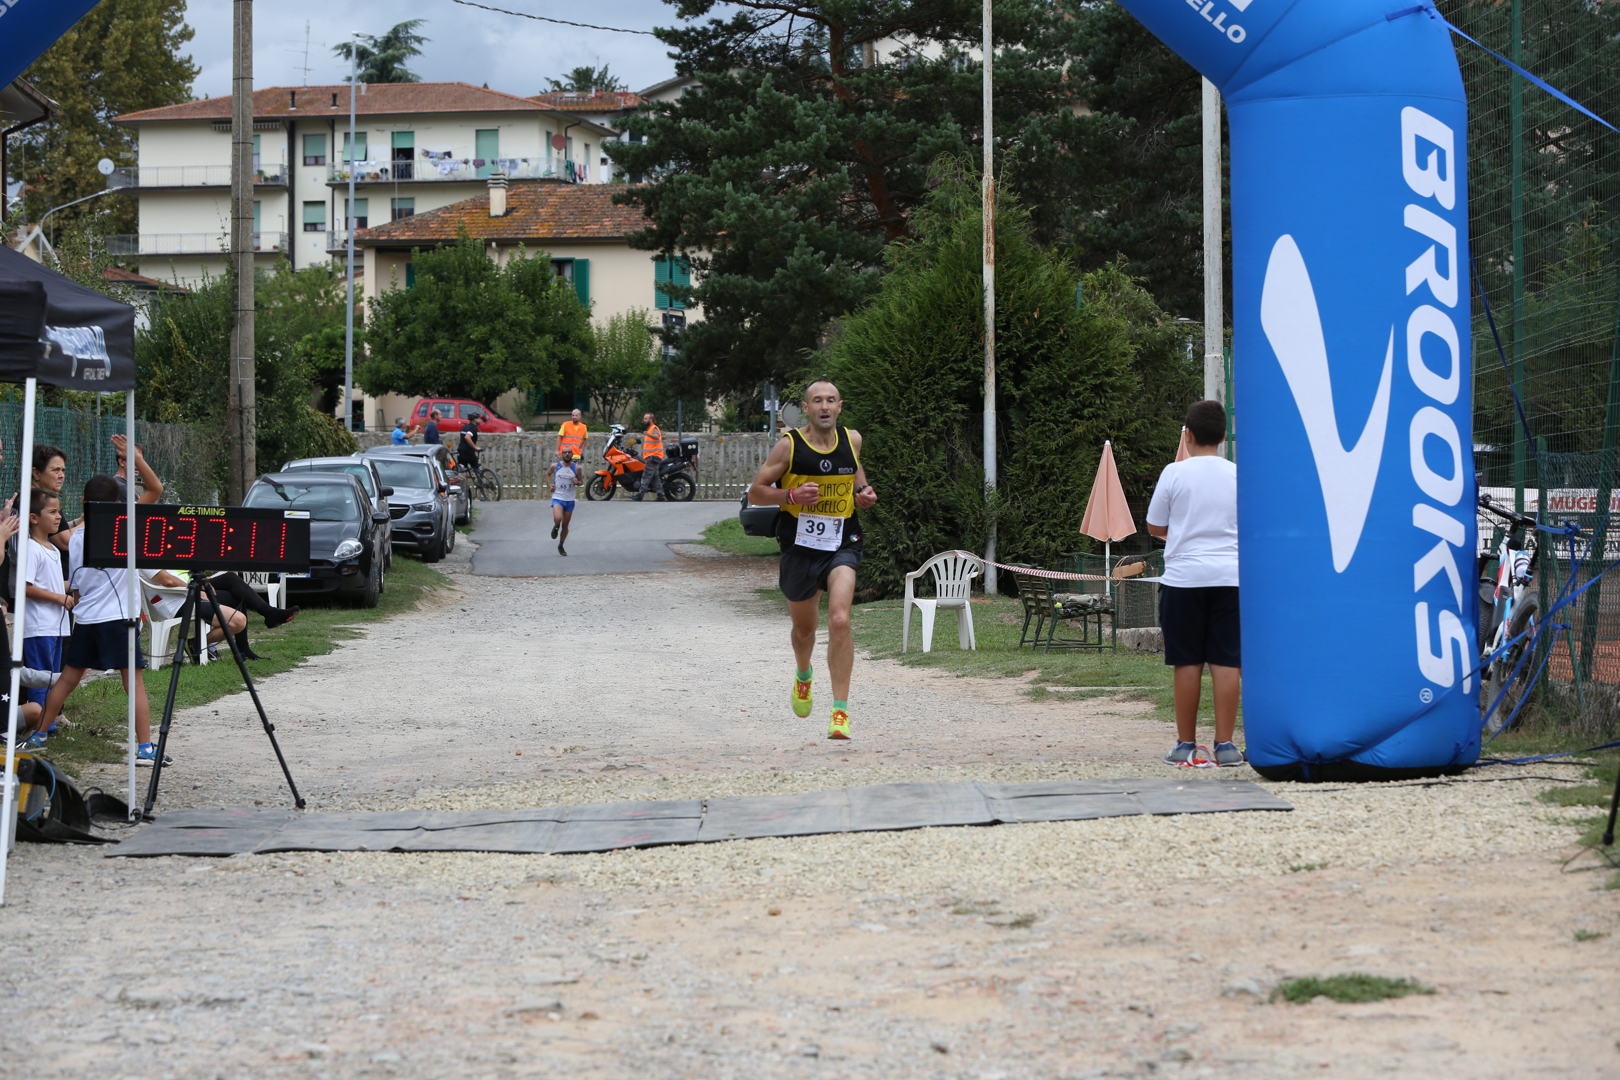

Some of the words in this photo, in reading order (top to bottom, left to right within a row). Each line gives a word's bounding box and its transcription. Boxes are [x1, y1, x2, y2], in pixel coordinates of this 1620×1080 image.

[1401, 106, 1472, 694] BROOKS
[177, 506, 226, 516] ALGE-TIMING
[112, 515, 287, 558] 00:37:11
[805, 519, 826, 536] 39
